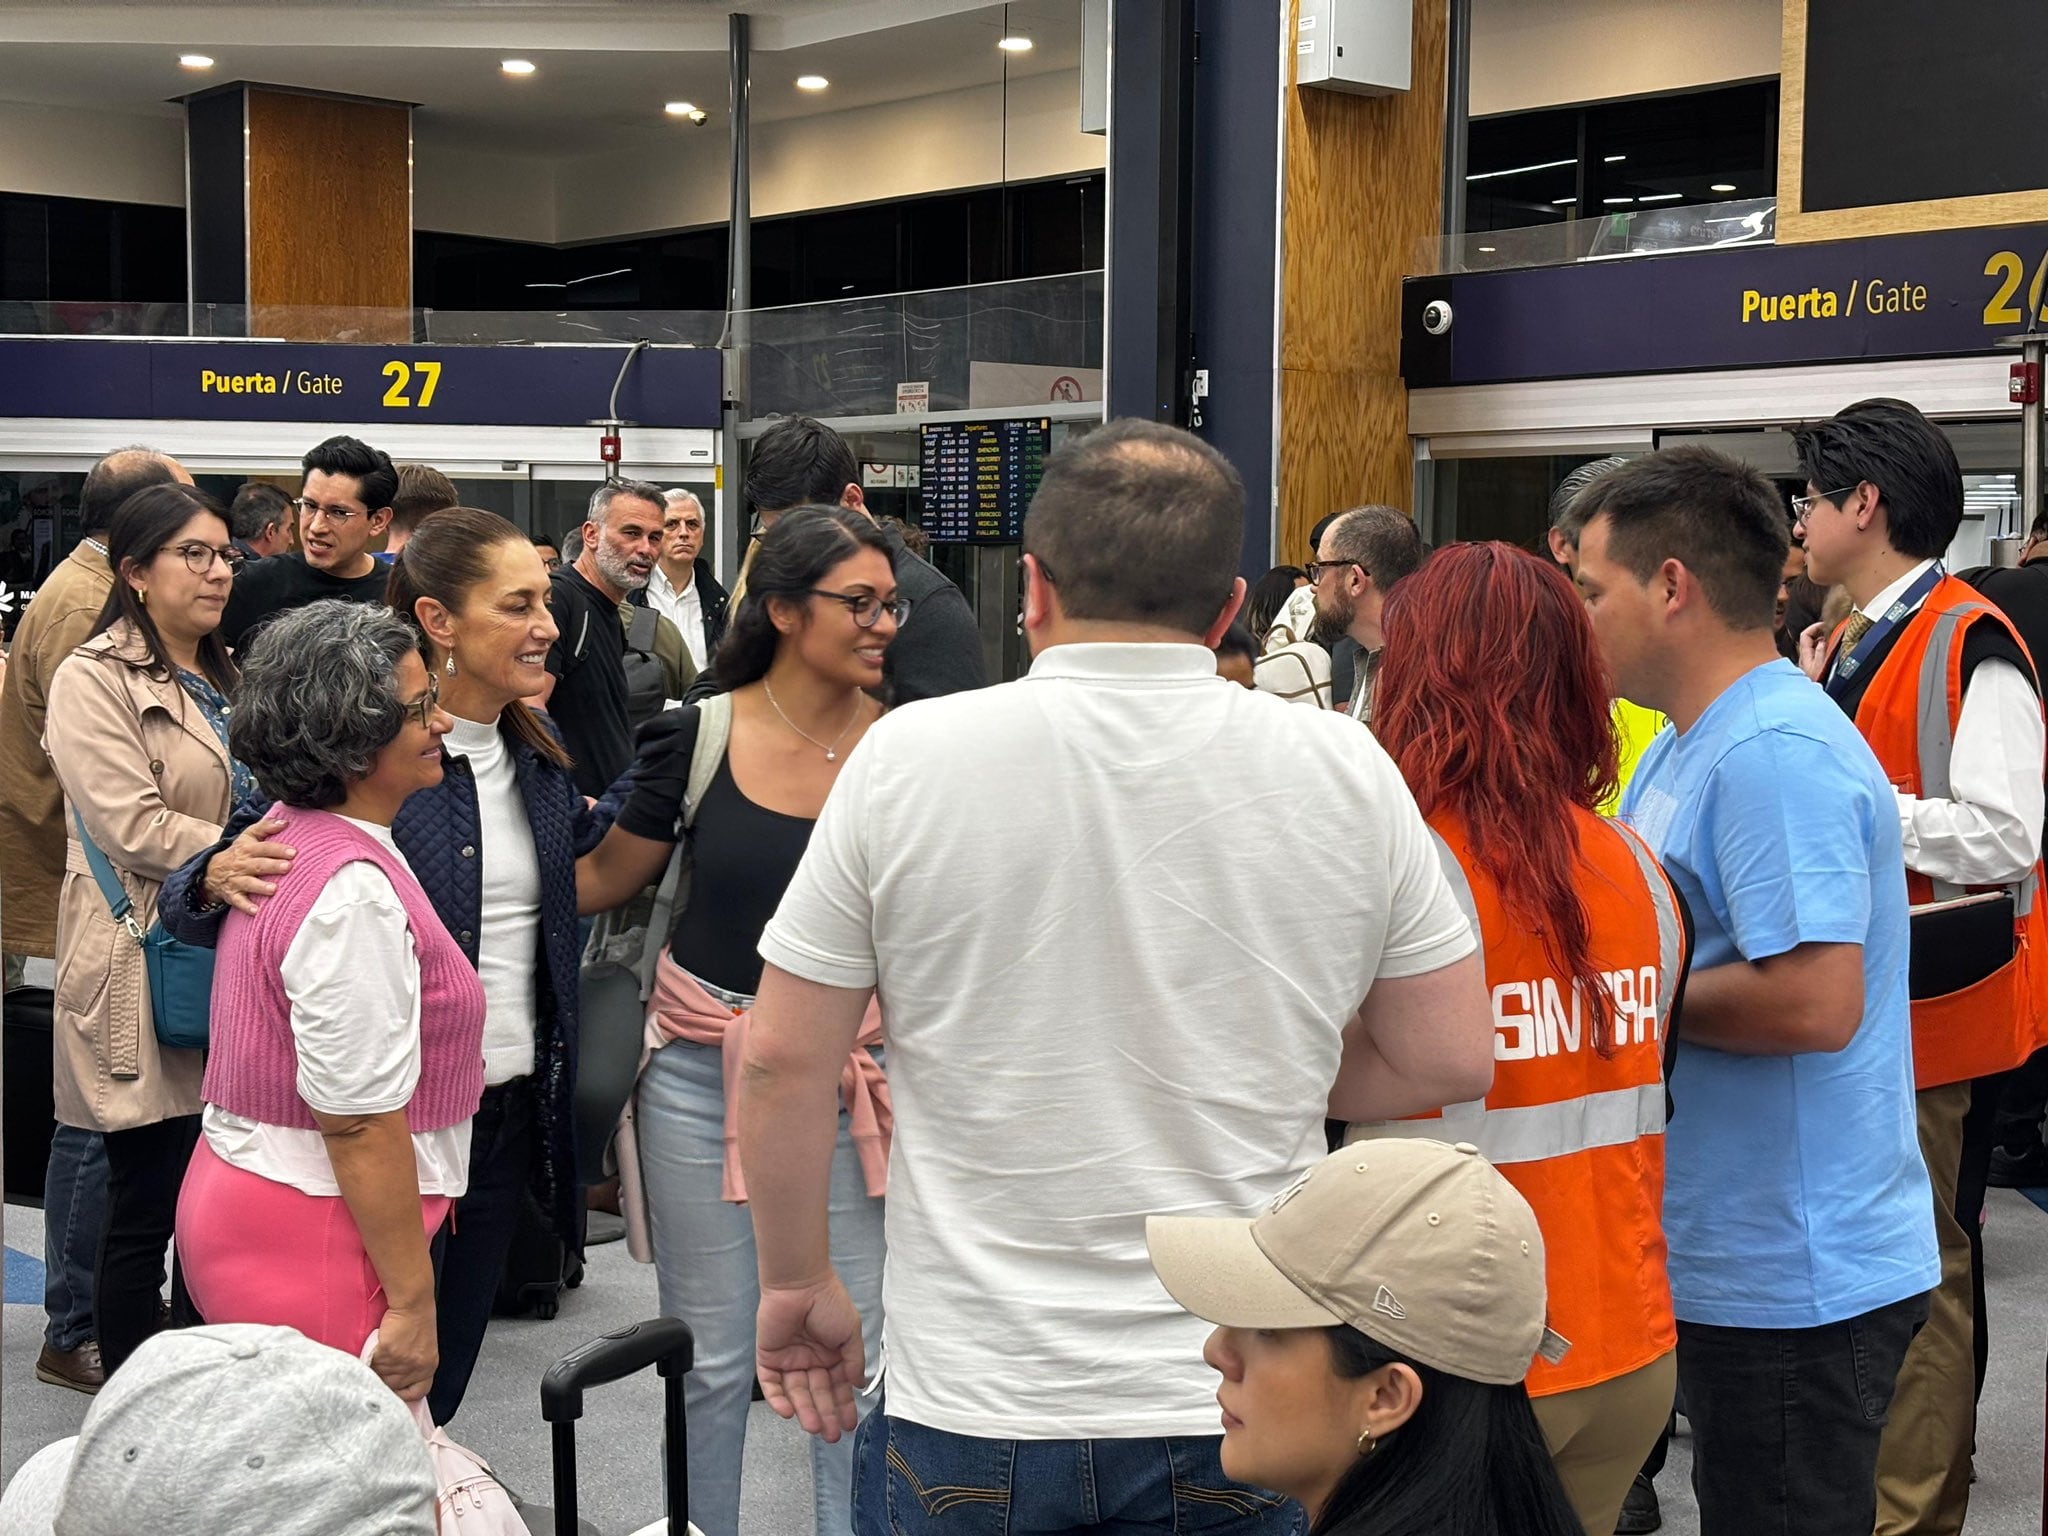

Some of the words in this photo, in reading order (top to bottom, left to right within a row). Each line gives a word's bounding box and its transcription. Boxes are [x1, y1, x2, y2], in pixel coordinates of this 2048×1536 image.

[1742, 287, 1837, 323] Puerta
[1845, 279, 1858, 317] /
[1866, 279, 1927, 315] Gate
[201, 370, 276, 393] Puerta
[282, 370, 291, 394] /
[297, 371, 343, 394] Gate
[382, 360, 442, 407] 27
